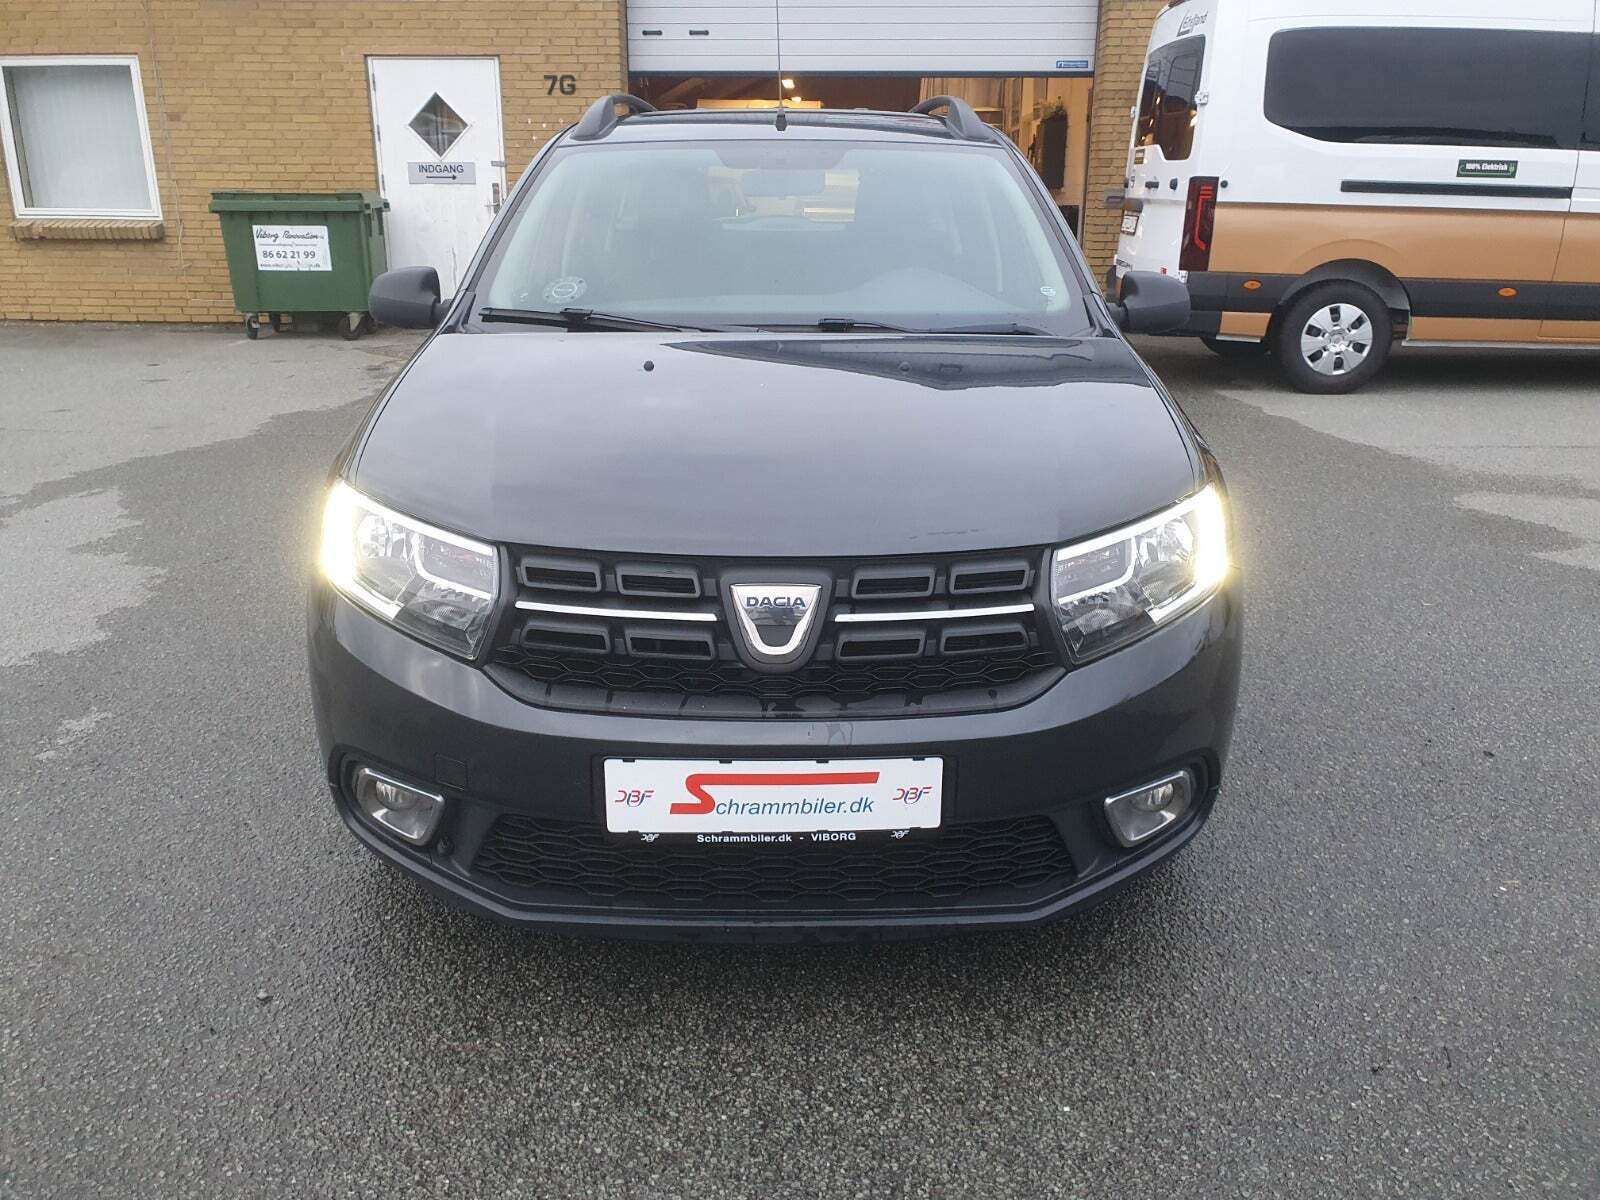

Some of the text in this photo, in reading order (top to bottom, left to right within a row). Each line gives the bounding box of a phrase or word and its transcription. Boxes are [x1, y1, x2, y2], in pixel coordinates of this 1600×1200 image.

[543, 74, 577, 97] 7G
[418, 164, 465, 174] INDGANG
[262, 250, 316, 259] 86 62 21 99
[746, 596, 806, 608] DACIA
[697, 834, 793, 843] Schrammbiler.dk
[810, 832, 857, 841] VIBORG
